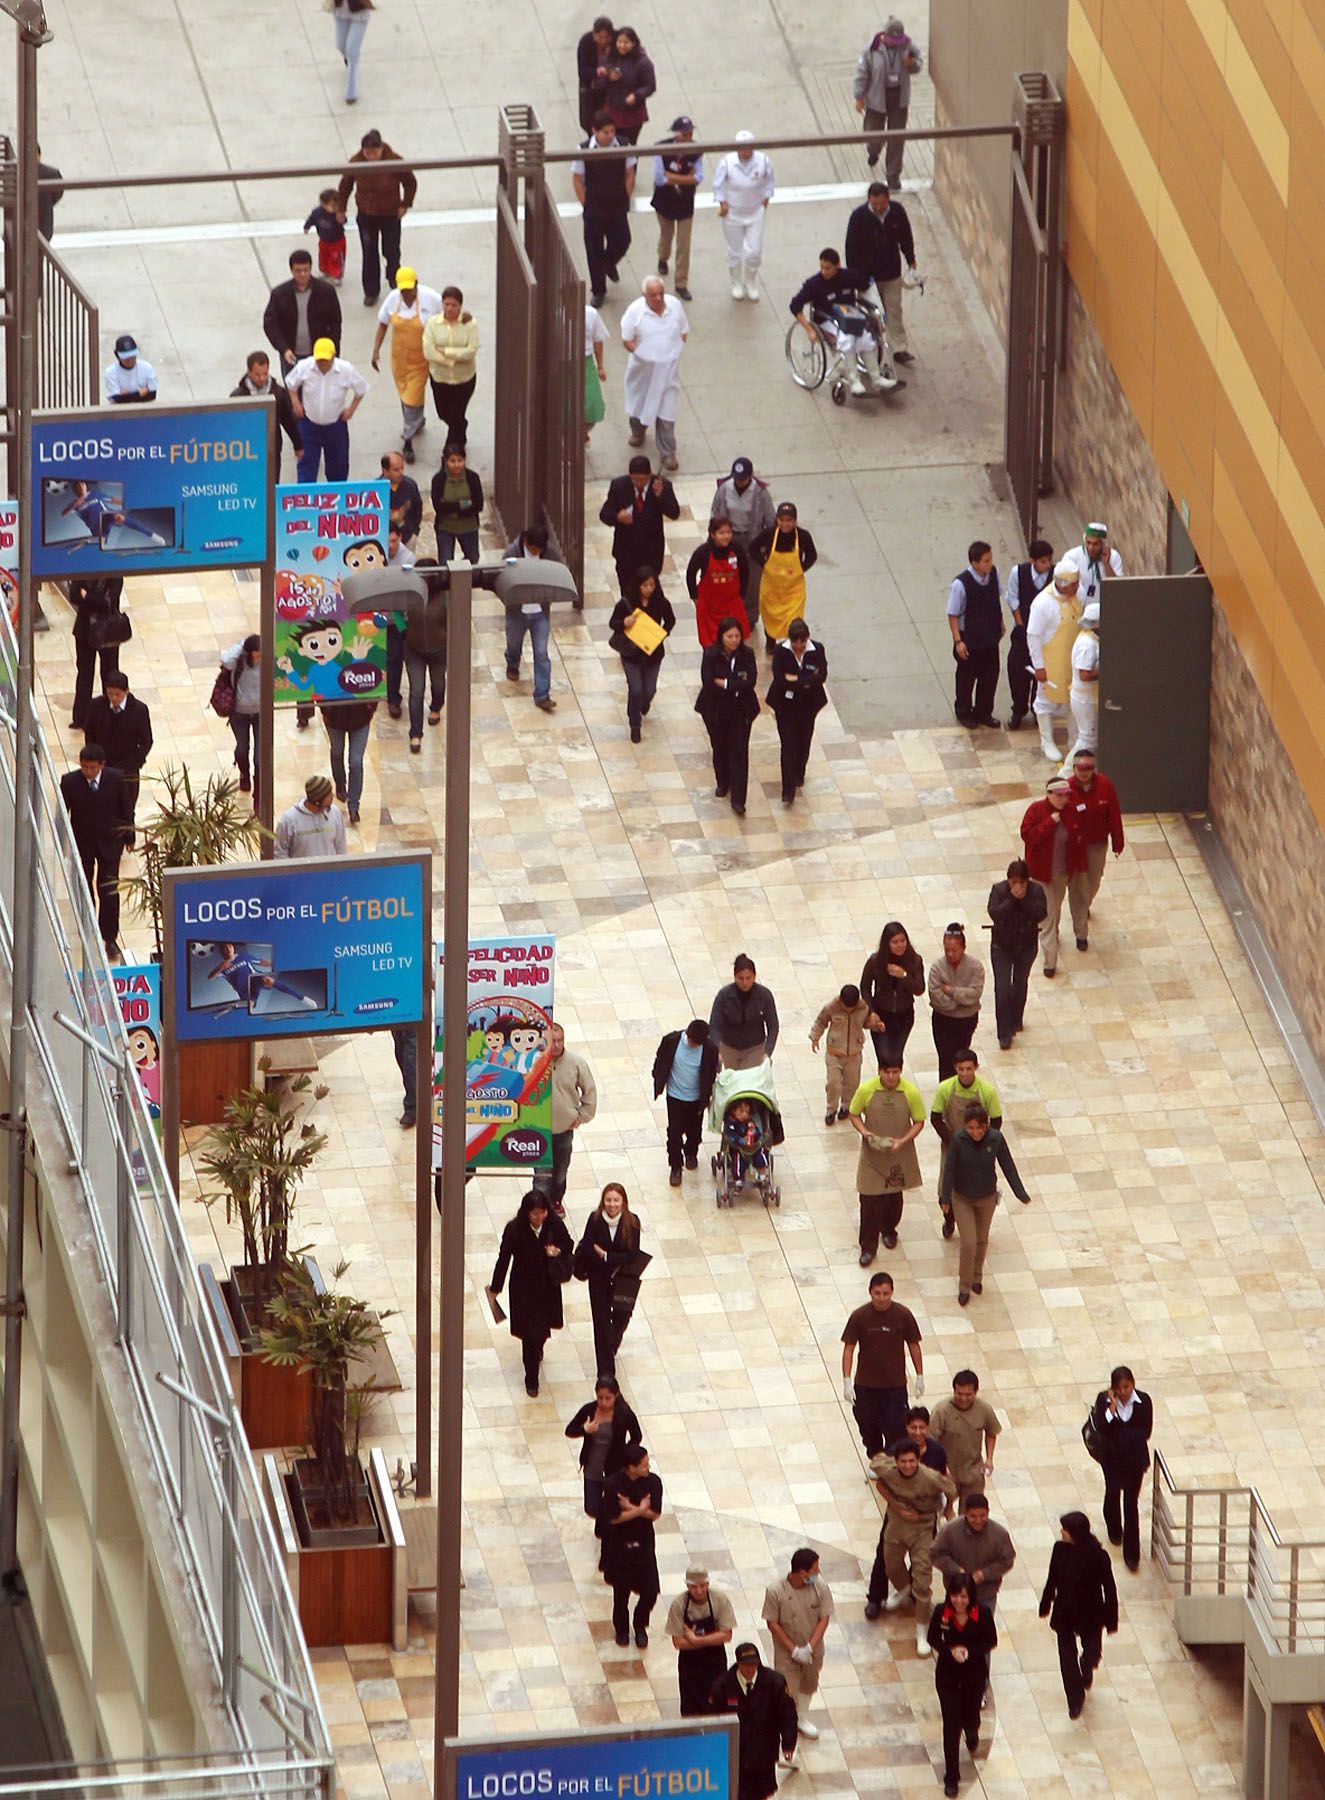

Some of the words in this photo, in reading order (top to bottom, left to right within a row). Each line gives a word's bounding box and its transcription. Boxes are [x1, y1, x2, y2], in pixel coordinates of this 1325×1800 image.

[39, 438, 114, 463] LOCOS
[117, 447, 145, 461] POR
[149, 445, 166, 459] EL
[169, 437, 258, 465] FÚTBOL
[181, 483, 238, 497] SAMSUNG
[218, 499, 240, 511] LED
[243, 498, 257, 509] TV
[282, 493, 341, 512] FELIZ
[345, 490, 382, 511] DÍA
[286, 520, 313, 535] DEL
[317, 511, 380, 539] NIÑO
[289, 581, 304, 595] 15
[345, 671, 376, 685] Real
[184, 898, 263, 923] LOCOS
[266, 905, 295, 920] POR
[300, 904, 318, 918] EL
[321, 896, 413, 924] FÚTBOL
[334, 942, 393, 957] SAMSUNG
[468, 945, 554, 964] FELICIDAD
[372, 958, 395, 971] LED
[398, 957, 413, 968] TV
[468, 968, 497, 984] SER
[503, 963, 550, 987] NIÑO
[358, 1001, 394, 1010] SAMSUNG
[466, 1087, 509, 1099] GOSTO
[479, 1103, 513, 1118] NIÑO
[508, 1137, 541, 1152] Real
[467, 1768, 553, 1799] LOCOS
[557, 1777, 589, 1795] POR
[594, 1777, 613, 1792] EL
[617, 1765, 719, 1798] FÚTBOL
